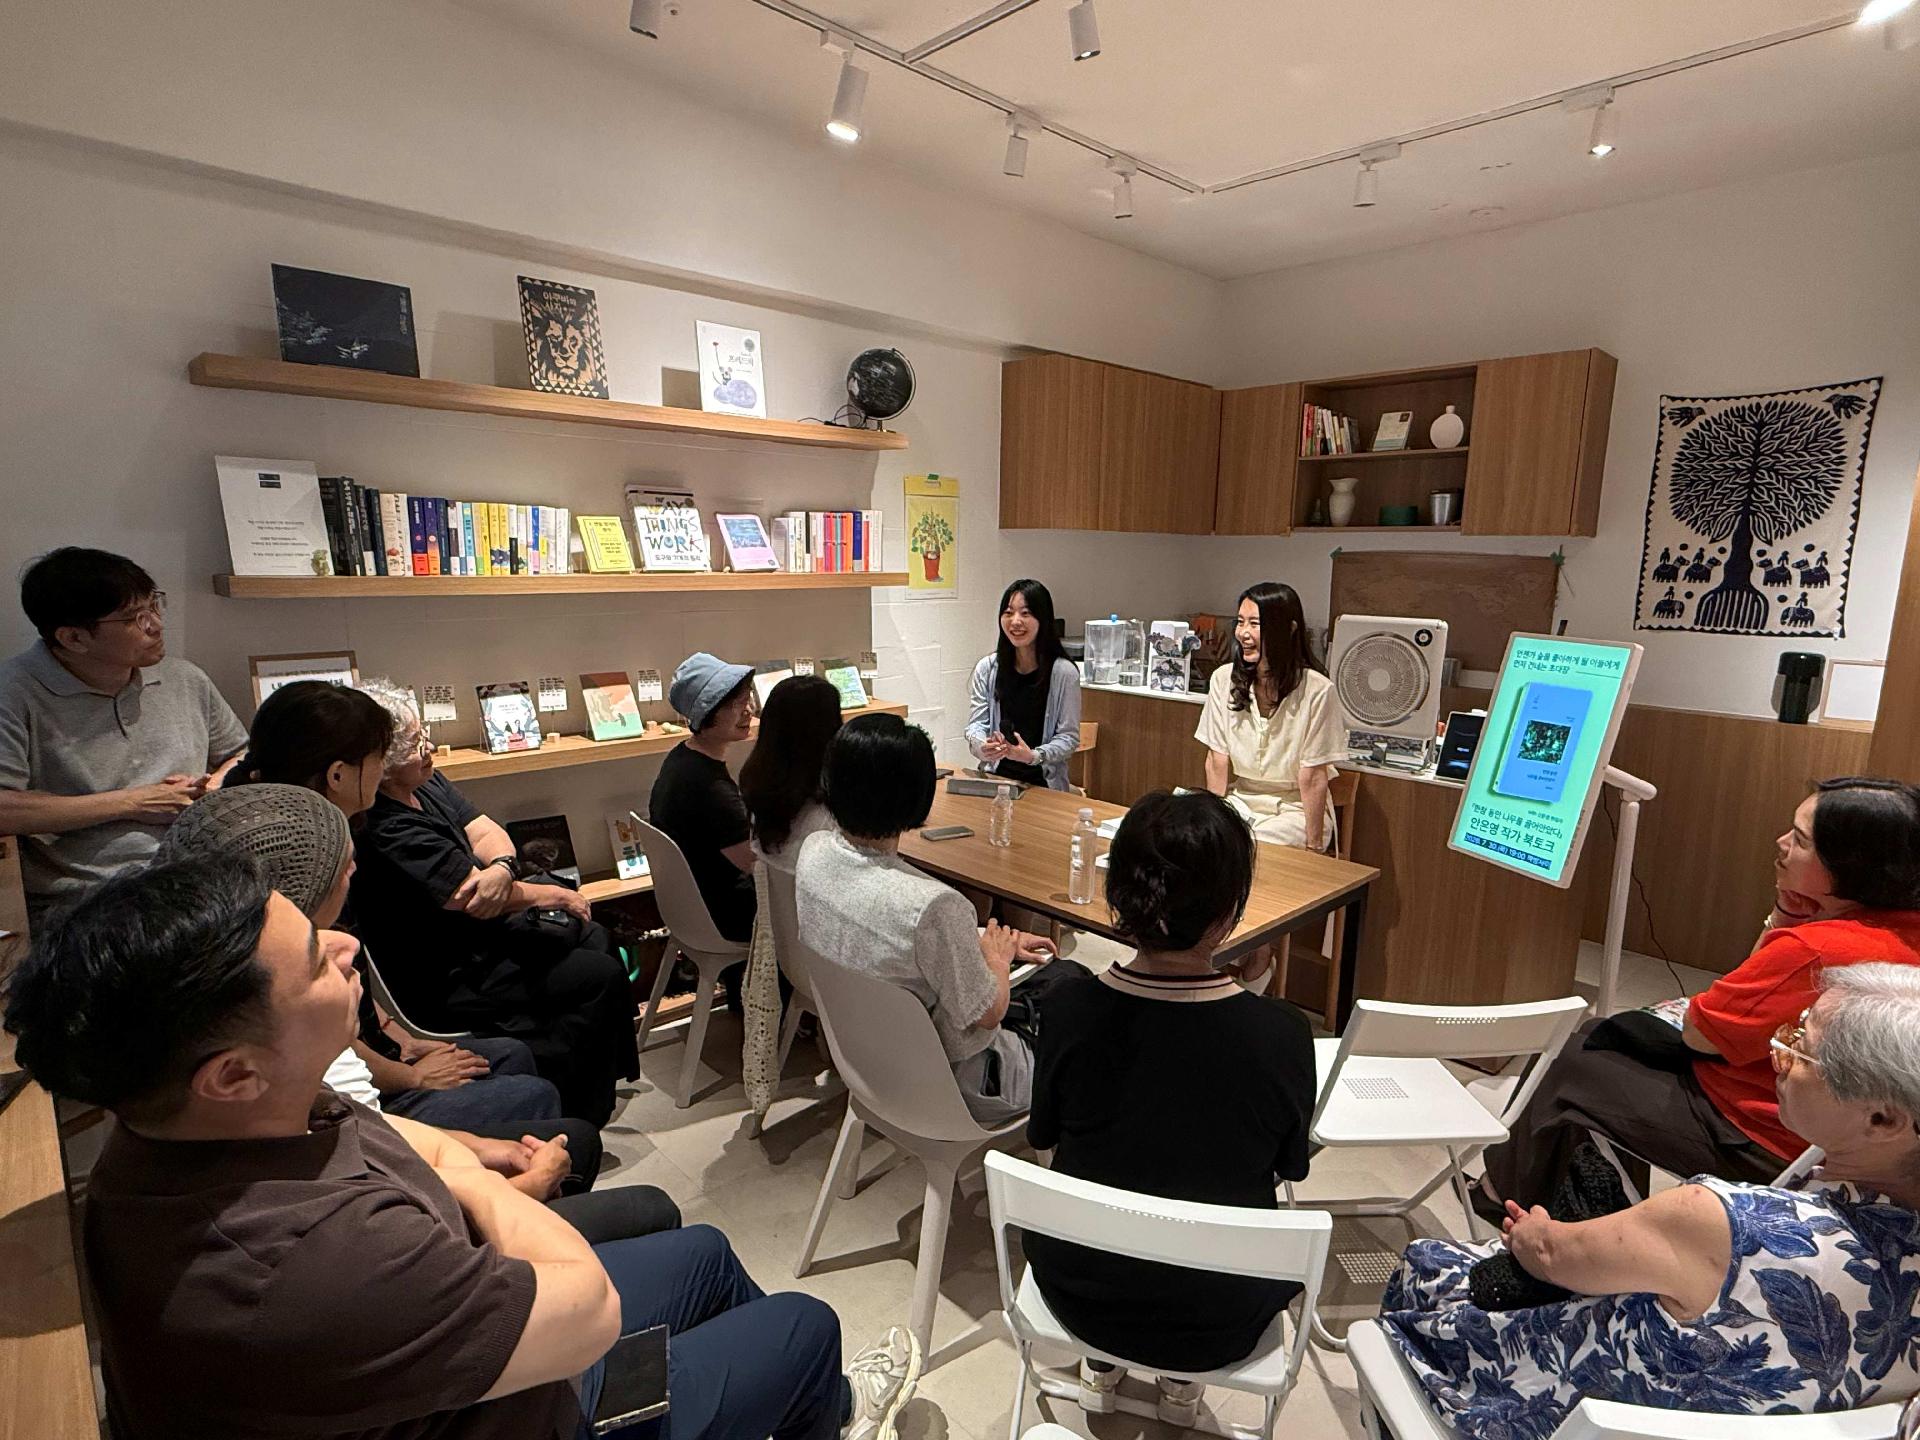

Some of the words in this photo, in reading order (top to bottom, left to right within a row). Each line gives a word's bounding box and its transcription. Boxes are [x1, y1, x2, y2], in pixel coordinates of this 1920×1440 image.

[640, 516, 698, 536] THINGS
[645, 535, 703, 553] WORK
[1516, 649, 1536, 659] 언젠가
[1552, 653, 1580, 665] 좋아하게
[1513, 659, 1527, 669] 먼저
[1528, 661, 1547, 671] 건네는
[1548, 664, 1570, 674] 초대장
[1488, 808, 1502, 820] 동안
[1502, 813, 1523, 826] 나무를
[1470, 817, 1500, 836] 안은영
[1501, 826, 1521, 843] 작가
[1523, 833, 1555, 853] 북토크
